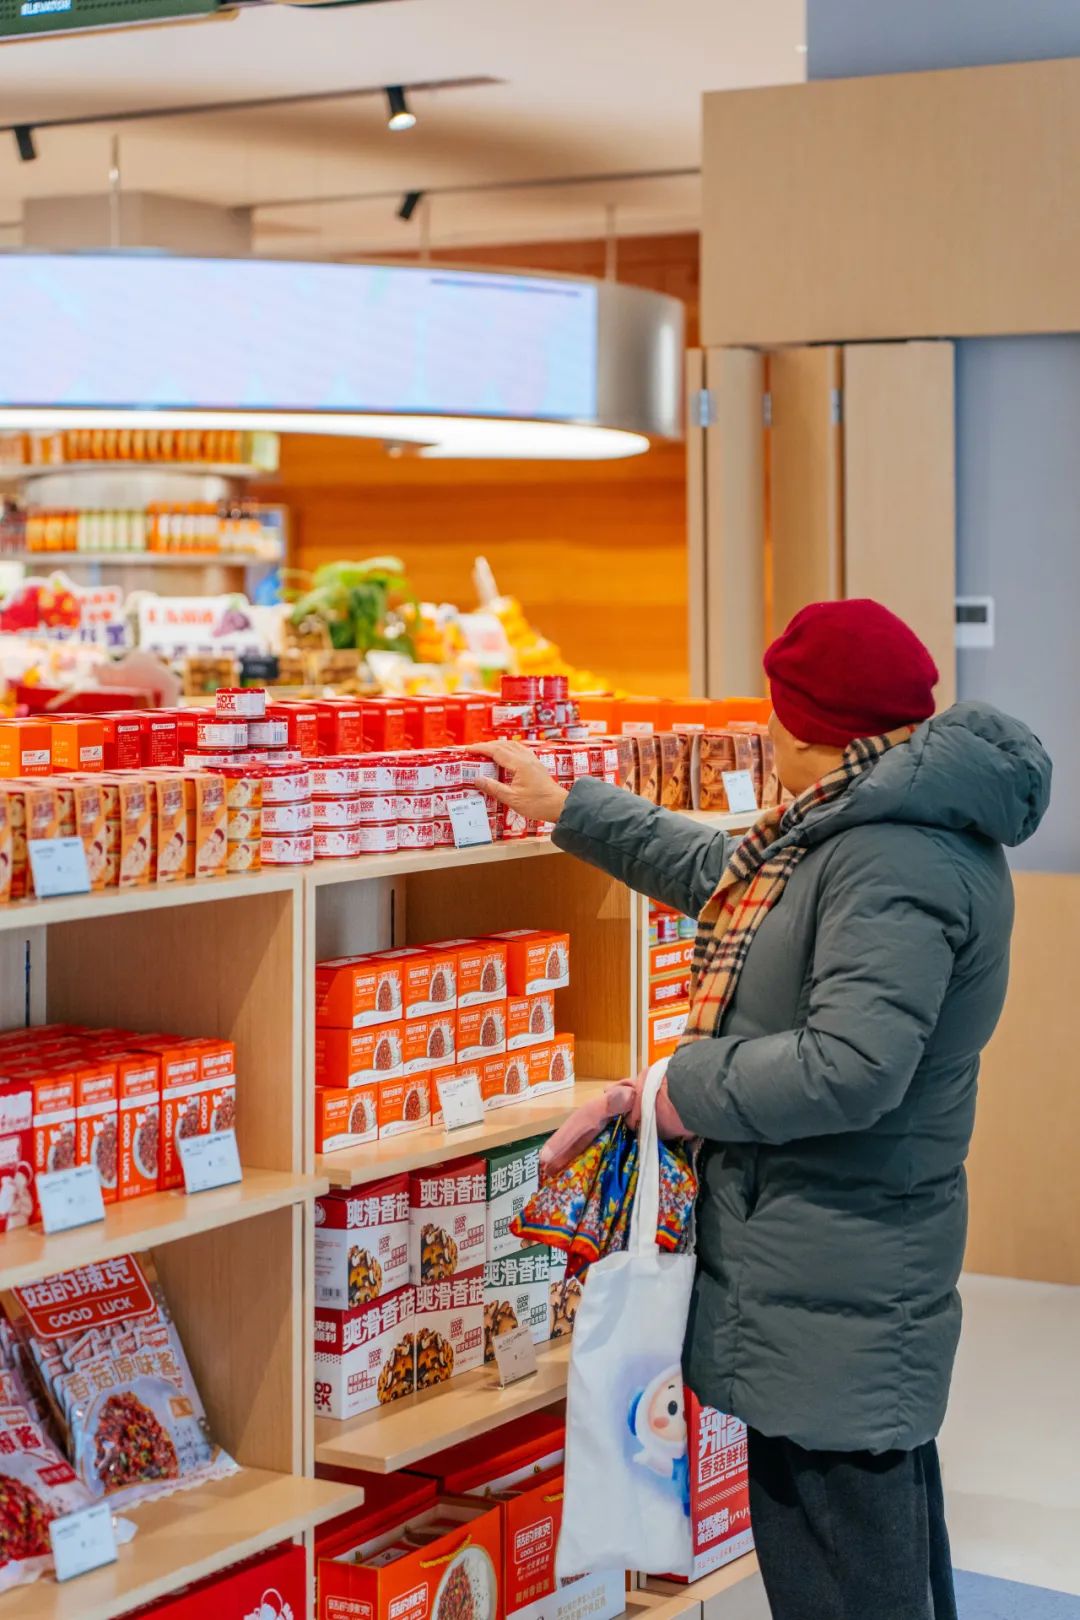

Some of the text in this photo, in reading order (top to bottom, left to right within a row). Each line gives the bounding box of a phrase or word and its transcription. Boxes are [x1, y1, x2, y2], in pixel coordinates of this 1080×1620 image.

[420, 1174, 486, 1208] 爽滑香菇
[490, 1148, 540, 1198] 爽滑香
[346, 1192, 410, 1230] 爽滑香菇
[484, 1254, 550, 1289] 爽滑香菇
[48, 1296, 134, 1328] GOOD LUCK
[415, 1276, 485, 1313] 爽滑香菇
[343, 1288, 416, 1351] 爽滑香菇
[535, 1541, 548, 1552] LUCK
